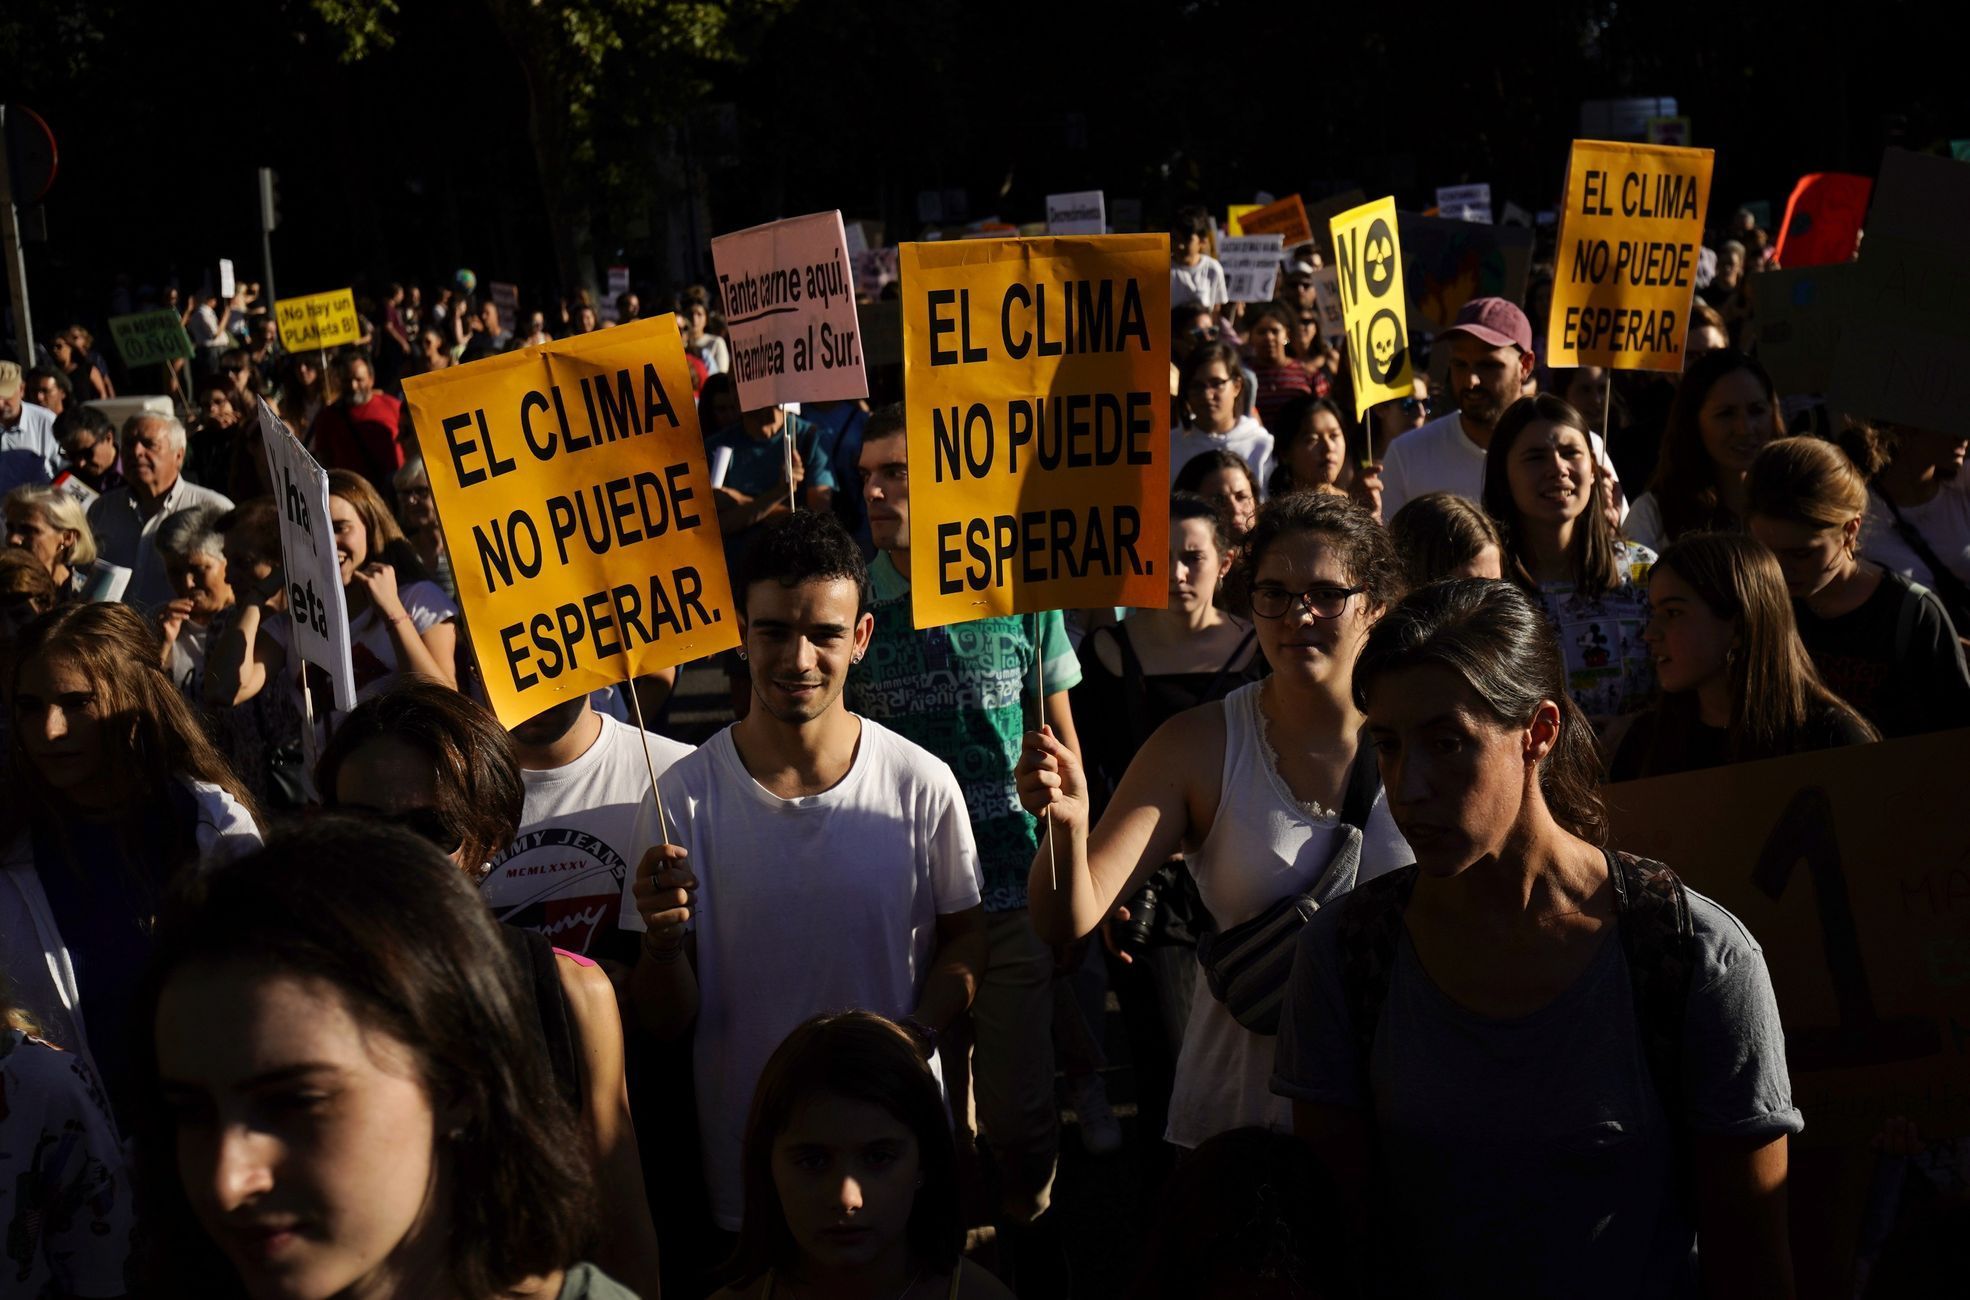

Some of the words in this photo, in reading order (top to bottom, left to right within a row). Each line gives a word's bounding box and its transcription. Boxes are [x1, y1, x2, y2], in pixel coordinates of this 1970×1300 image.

[1583, 170, 1613, 216] EL
[1621, 172, 1698, 220] CLIMA
[720, 272, 759, 317] Tanta
[760, 268, 801, 308] carne
[806, 248, 849, 309] aquí,
[1571, 240, 1610, 283] NO
[1614, 241, 1693, 287] PUEDE
[733, 335, 785, 383] hambrea
[793, 325, 813, 372] al
[821, 322, 860, 370] Sur.
[927, 289, 988, 366] EL
[1001, 278, 1151, 360] CLIMA
[1563, 307, 1679, 353] ESPERAR.
[442, 408, 516, 488] EL
[520, 363, 680, 462] CLIMA
[933, 403, 994, 483] NO
[1008, 392, 1152, 474] PUEDE
[472, 509, 543, 593] NO
[546, 462, 701, 565] PUEDE
[938, 505, 1153, 595] ESPERAR.
[500, 566, 721, 692] ESPERAR.
[490, 830, 548, 873] MMY
[557, 830, 627, 880] JEANS
[506, 860, 588, 879] MCMLXXXV
[1750, 784, 1943, 1073] 1
